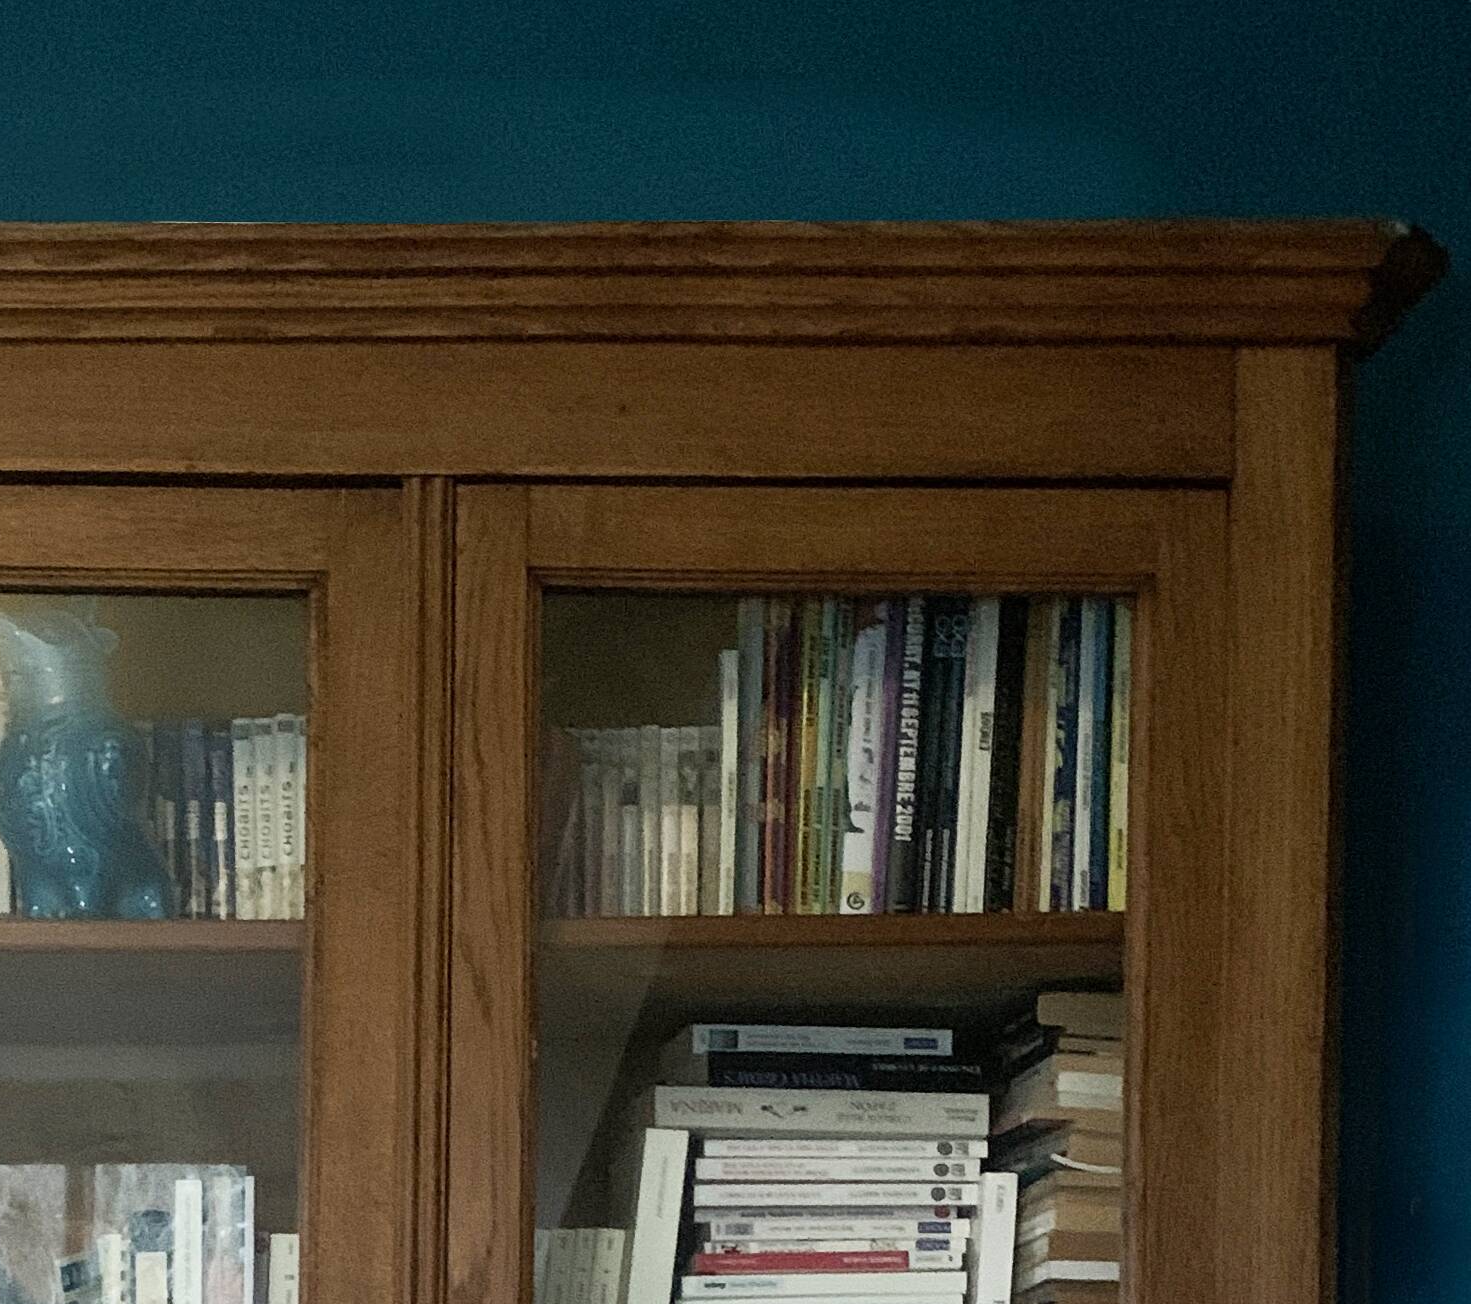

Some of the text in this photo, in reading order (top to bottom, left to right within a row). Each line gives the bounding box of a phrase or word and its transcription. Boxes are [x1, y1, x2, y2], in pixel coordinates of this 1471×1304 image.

[896, 708, 920, 803] SEPTEMBRE
[237, 784, 251, 860] CHOBITS
[259, 784, 273, 860] CHOBITS
[282, 780, 295, 857] CHOBITS
[893, 804, 913, 842] 2001
